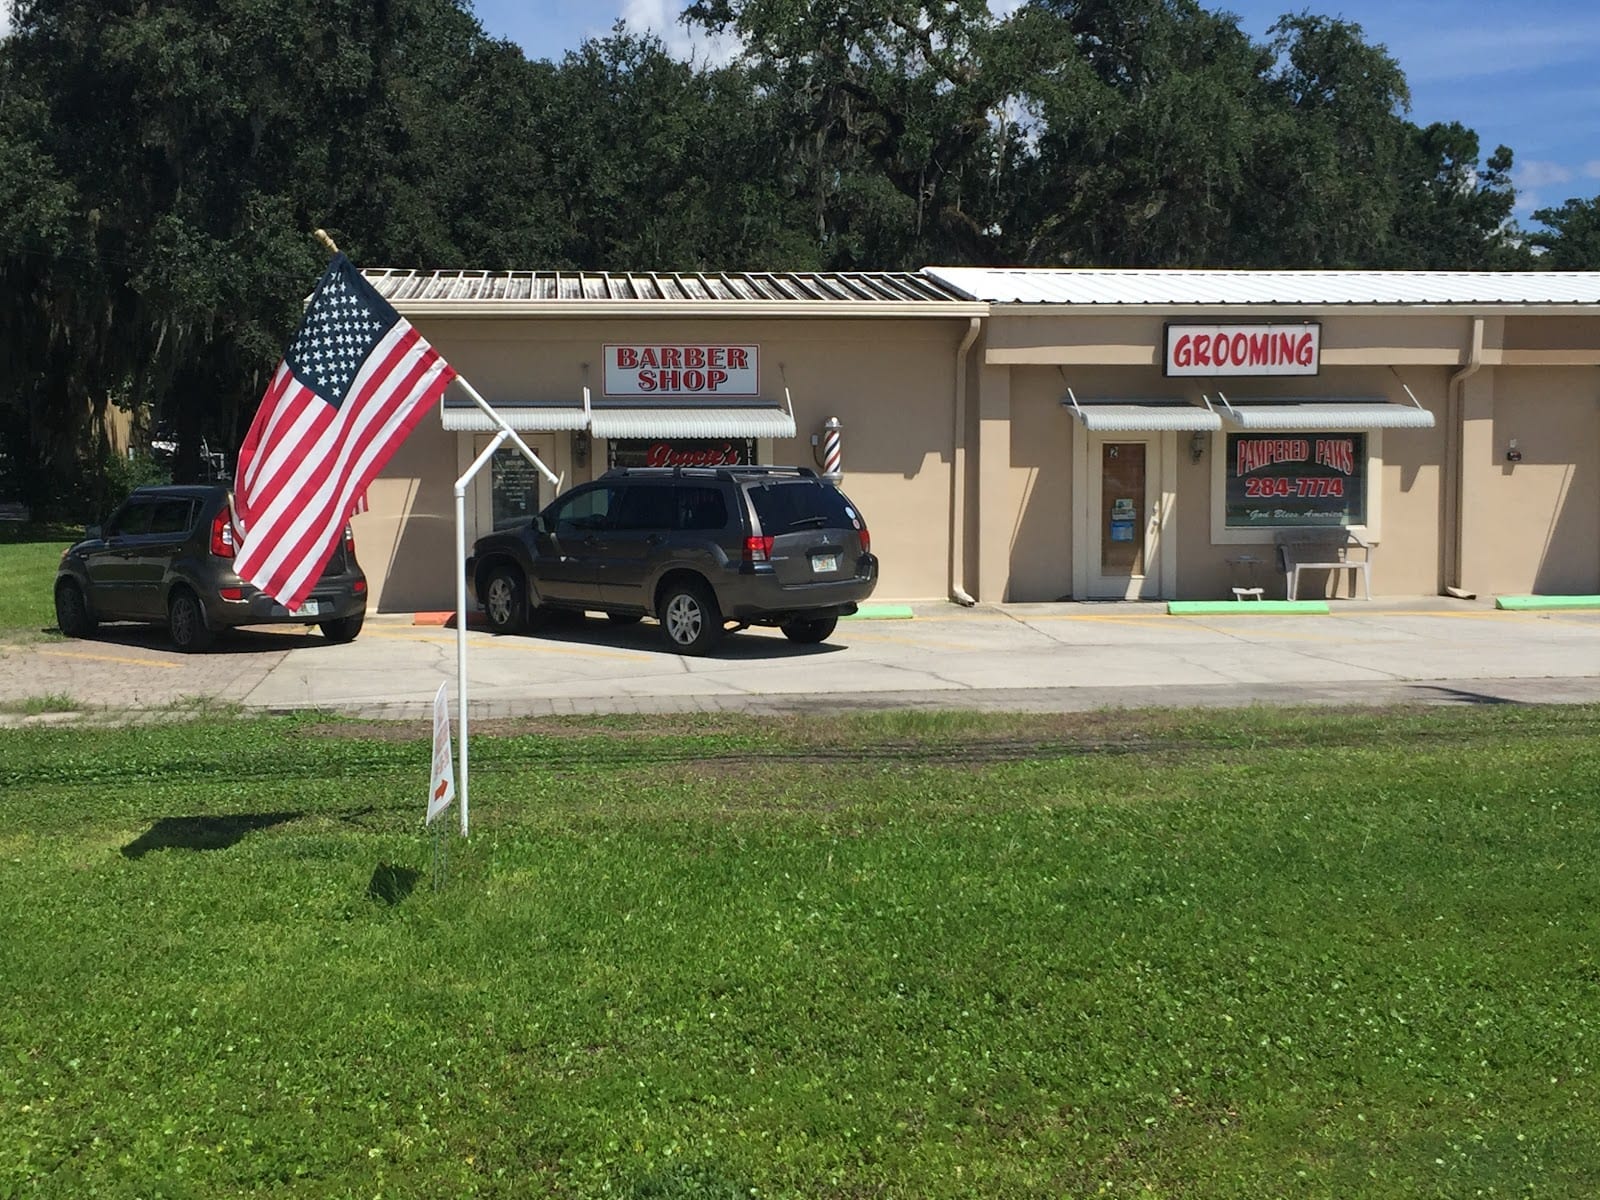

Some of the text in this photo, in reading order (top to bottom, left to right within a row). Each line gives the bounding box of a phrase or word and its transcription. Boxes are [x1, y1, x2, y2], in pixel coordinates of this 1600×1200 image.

[616, 347, 749, 370] BARBER
[1173, 332, 1313, 367] GROOMING
[638, 369, 728, 392] SHOP
[1236, 438, 1354, 477] PAMPERED PAWS
[1245, 477, 1344, 498] 284-7774
